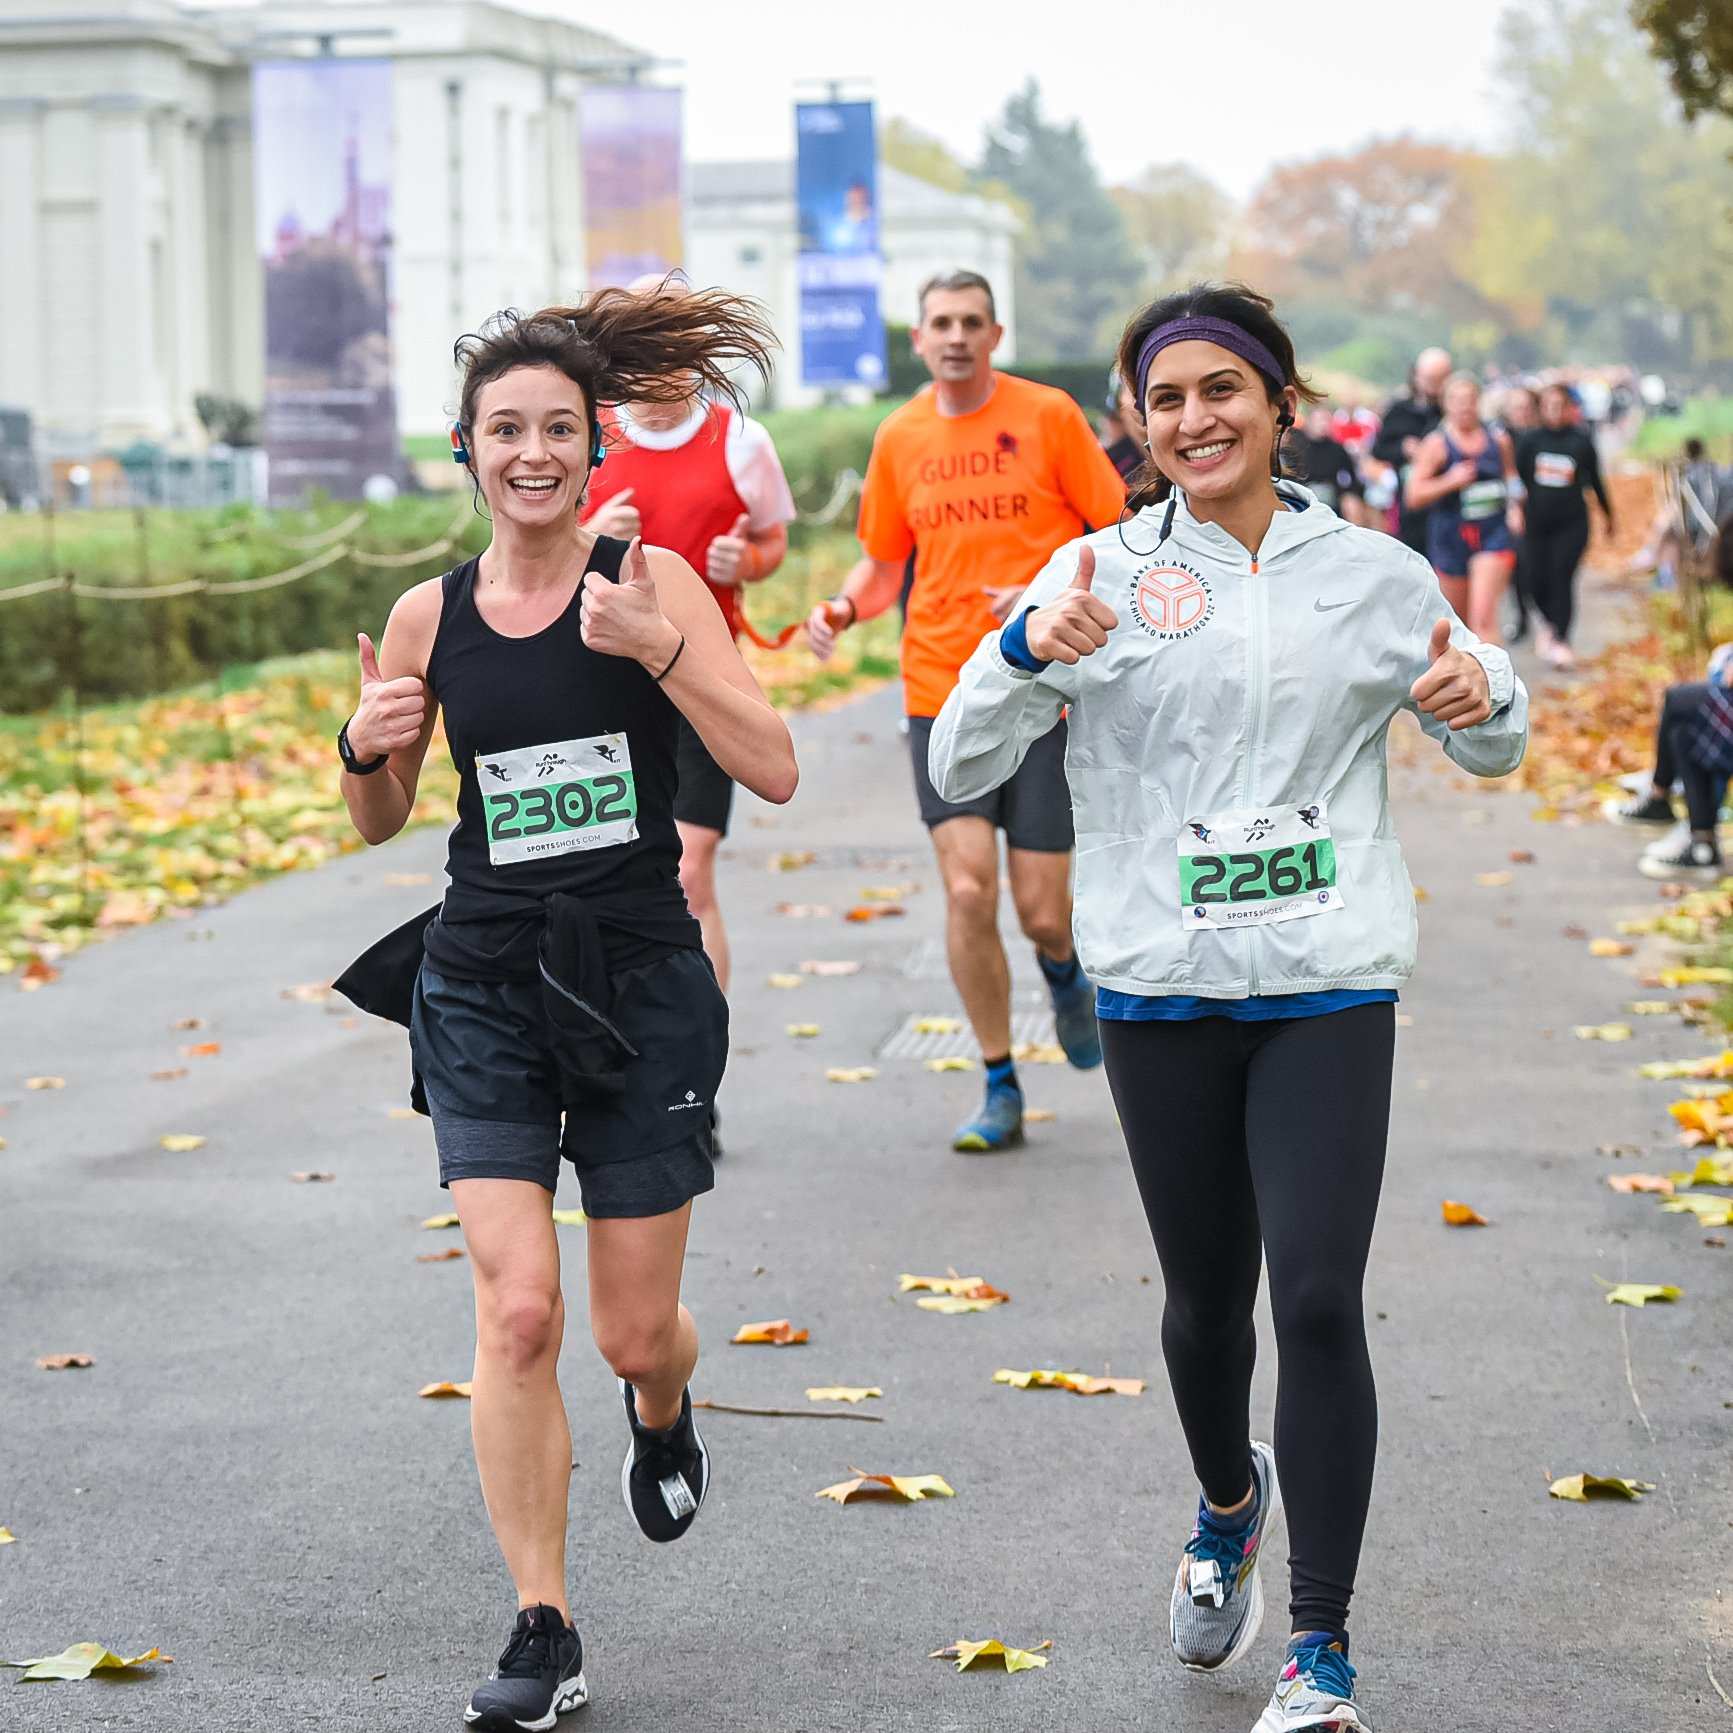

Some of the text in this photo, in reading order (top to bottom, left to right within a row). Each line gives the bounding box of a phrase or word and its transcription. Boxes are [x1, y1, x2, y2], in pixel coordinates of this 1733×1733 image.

[919, 449, 1009, 485] GUIDE
[1130, 560, 1213, 595] BANK OF AMERICA
[1129, 600, 1157, 637] CHICAGO
[1159, 615, 1211, 641] MARATHON
[489, 774, 632, 841] 2302
[1190, 842, 1329, 904] 2261
